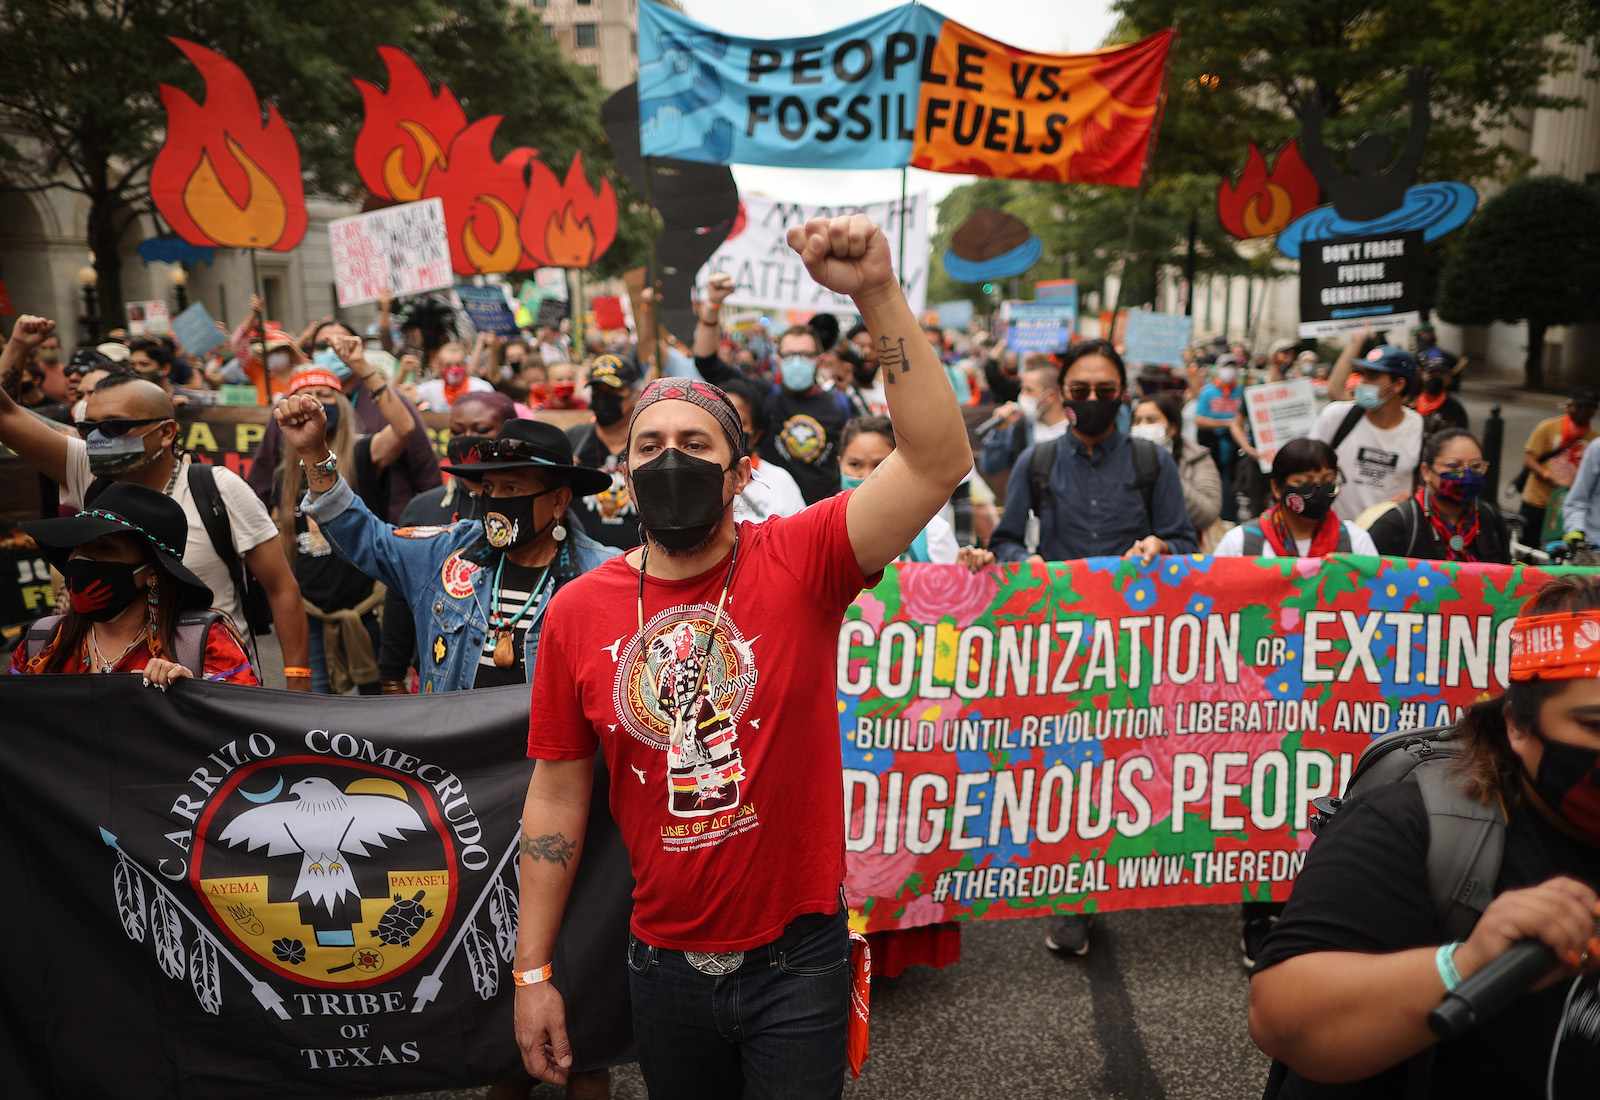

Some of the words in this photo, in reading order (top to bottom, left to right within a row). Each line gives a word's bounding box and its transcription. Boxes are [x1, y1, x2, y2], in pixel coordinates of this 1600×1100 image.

[747, 33, 988, 92] PEOPLE
[1010, 62, 1069, 102] VS.
[746, 93, 914, 142] FOSSIL
[924, 98, 1069, 155] FUELS
[1321, 242, 1362, 264] DON'T
[1363, 238, 1405, 260] FRACK
[1337, 261, 1386, 284] FUTURE
[1320, 281, 1404, 306] GENERATIONS
[1255, 637, 1287, 667] OR
[1526, 625, 1564, 654] FUELS
[856, 716, 936, 752] BUILD
[942, 715, 1019, 752] UNTIL
[1020, 705, 1169, 749] REVOLUTION,
[1175, 700, 1327, 736] LIBERATION,
[1333, 701, 1391, 734] AND
[157, 732, 277, 881] CARRIZO
[304, 729, 490, 871] COMECRUDO
[660, 824, 689, 837] LINES
[692, 820, 709, 834] OF
[209, 881, 260, 895] AYEMA
[390, 874, 450, 887] PAYASE'L
[932, 860, 1111, 903] #THEREDDEAL
[293, 991, 407, 1017] TRIBE
[339, 1023, 370, 1040] OF
[300, 1041, 421, 1069] TEXAS
